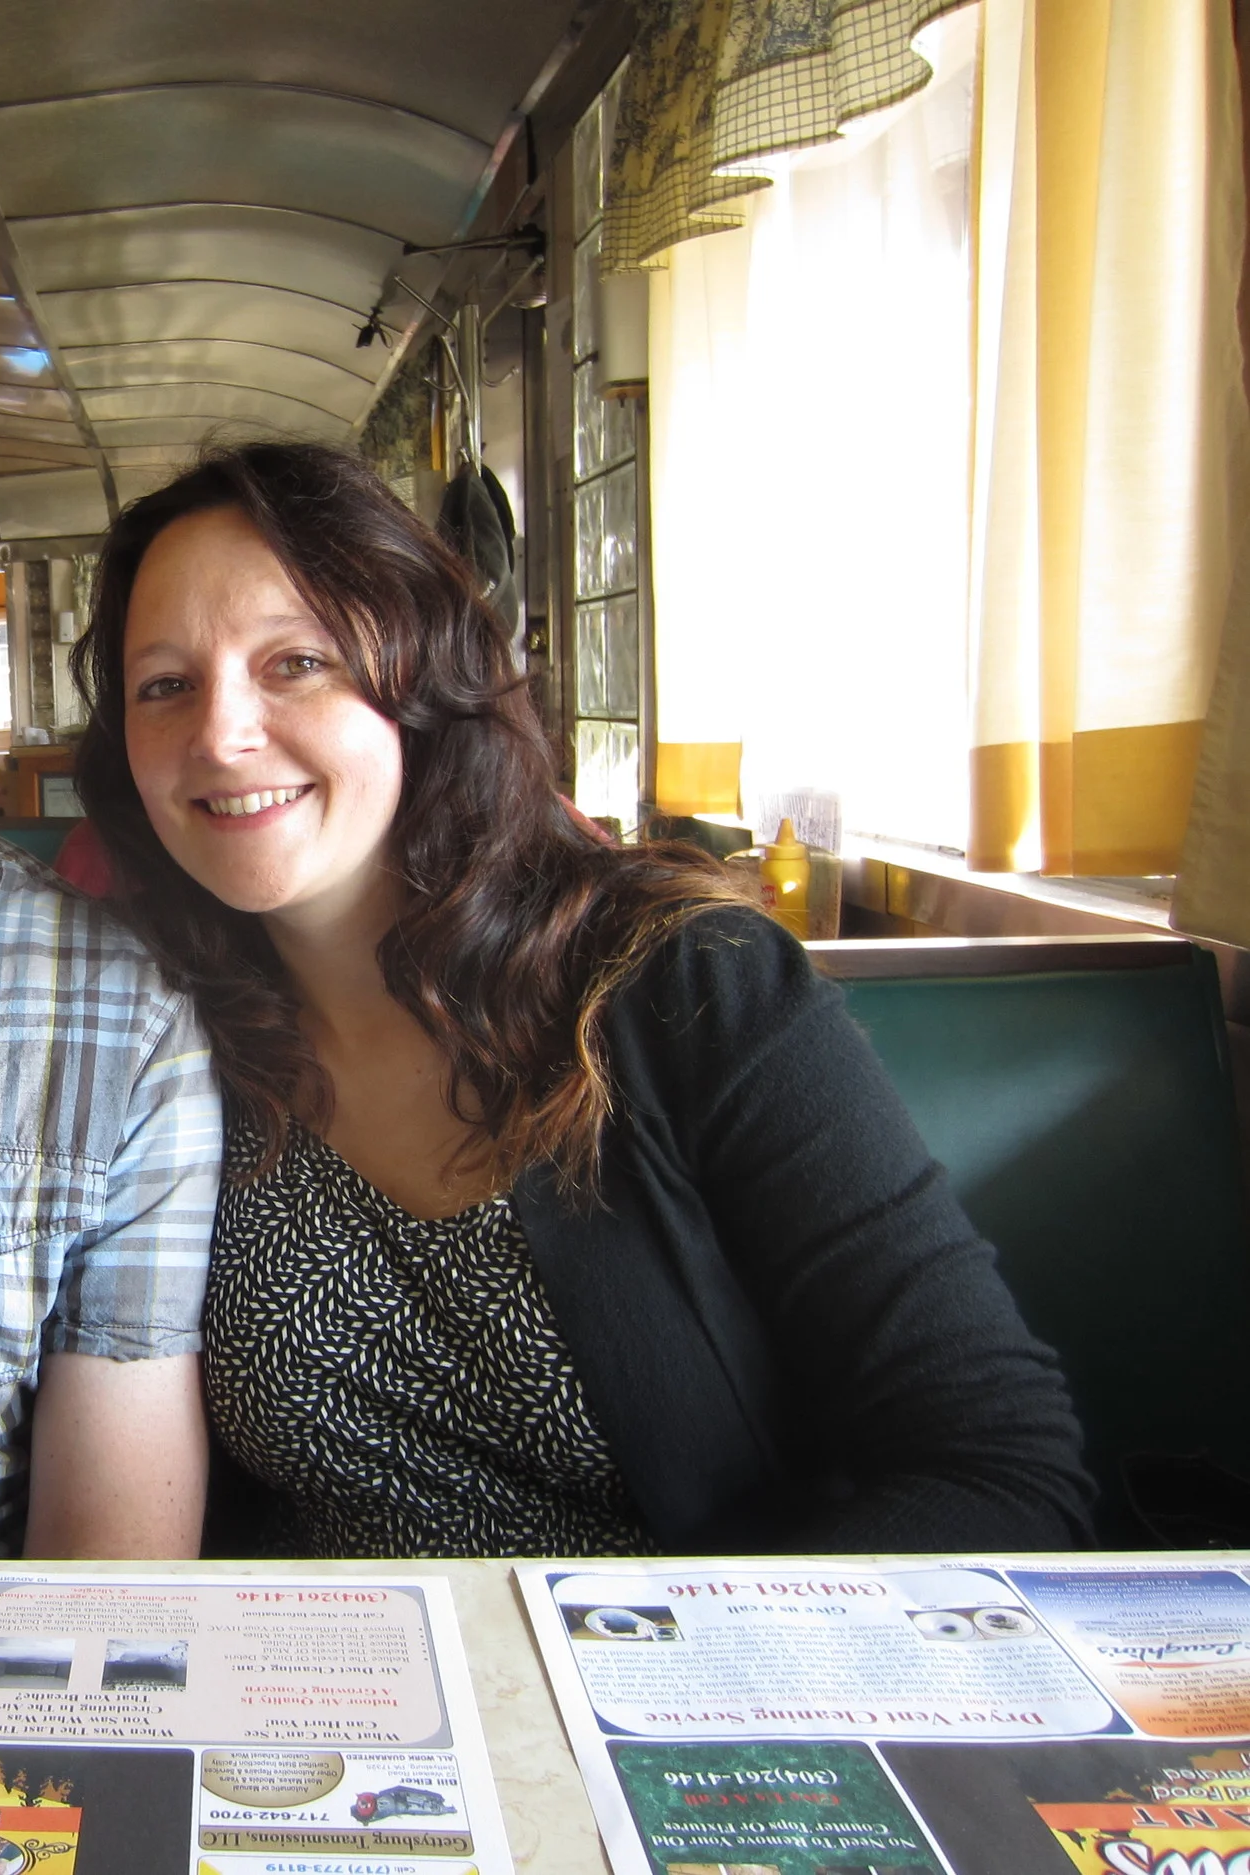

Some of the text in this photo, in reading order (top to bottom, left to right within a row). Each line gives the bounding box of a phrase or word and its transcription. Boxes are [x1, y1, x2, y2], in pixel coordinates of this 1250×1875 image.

[667, 1581, 887, 1599] (304)261-4146
[235, 1591, 387, 1603] (304)261-4146
[727, 1605, 847, 1616] Give us a call
[232, 1664, 402, 1675] Air Duct Cleaning Can:
[244, 1686, 392, 1696] A Growing Concern
[15, 1693, 150, 1703] That You Breathe?
[240, 1696, 398, 1707] Indoor Air Quality Is
[0, 1703, 163, 1714] Circulating In The Air
[7, 1714, 150, 1725] You Saw What Was
[644, 1707, 1045, 1726] Dryer Vent Cleaning Service
[265, 1719, 377, 1729] Can Hurt You!
[24, 1726, 54, 1734] Last
[60, 1726, 88, 1735] The
[94, 1727, 125, 1736] Was
[130, 1728, 174, 1737] When
[244, 1730, 401, 1741] What You Can't See
[212, 1758, 237, 1767] Facility
[238, 1759, 276, 1767] Inspection
[297, 1761, 329, 1769] Certified
[243, 1767, 272, 1776] Repairs
[317, 1769, 337, 1777] Other
[663, 1768, 838, 1785] (304)261-4146
[436, 1778, 458, 1786] Bill
[271, 1785, 309, 1793] Automatic
[209, 1810, 330, 1821] 717-642-9700
[663, 1819, 890, 1834] Counter Tops Or Fixtures
[203, 1831, 468, 1852] Gettysburg Transmissions, LLC
[651, 1834, 917, 1849] No Need To Remove Your Old
[265, 1863, 343, 1874] 773-8119
[349, 1864, 390, 1874] (717)
